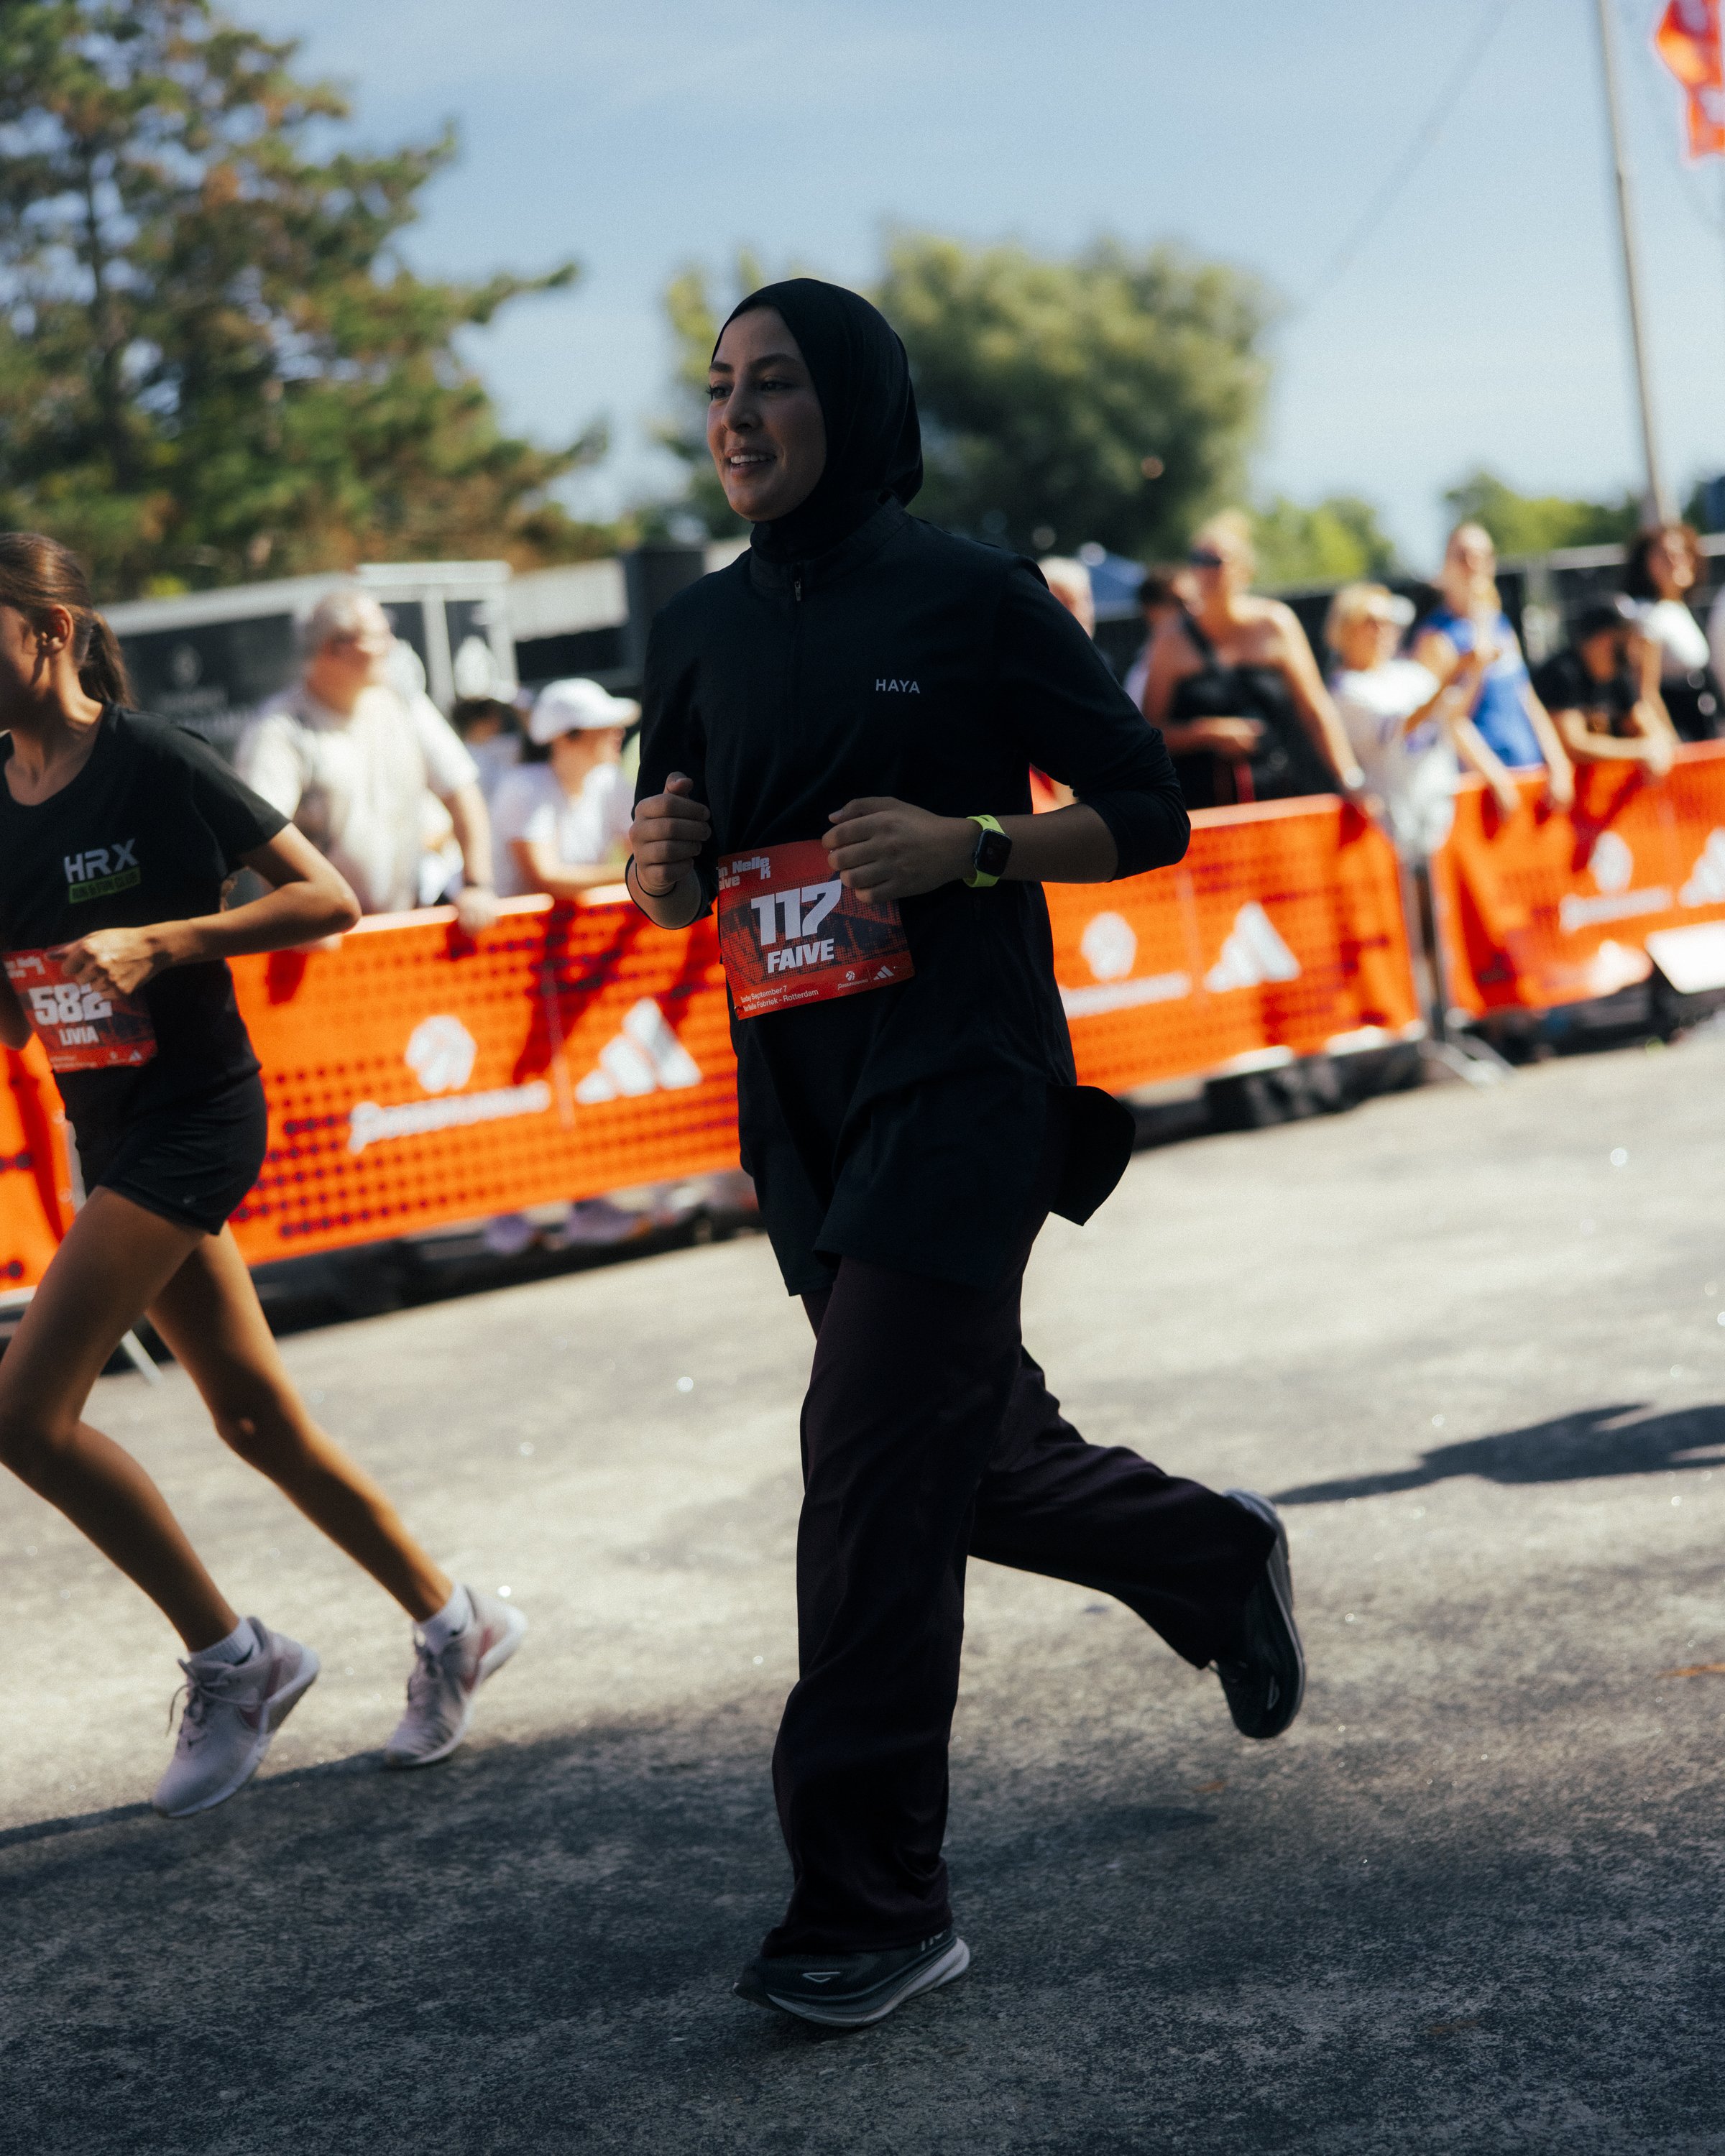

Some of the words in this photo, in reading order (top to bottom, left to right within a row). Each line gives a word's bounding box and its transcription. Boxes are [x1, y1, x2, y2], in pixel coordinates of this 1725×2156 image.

[875, 678, 921, 694] HAYA
[64, 838, 139, 884] HRX
[732, 856, 770, 875] Nelle
[760, 865, 771, 880] K
[750, 879, 842, 946] 117
[767, 938, 834, 974] FAIVE
[751, 988, 782, 1000] September
[757, 998, 778, 1008] Fabriek
[783, 990, 819, 1002] Rotterdam
[28, 982, 113, 1026] 582
